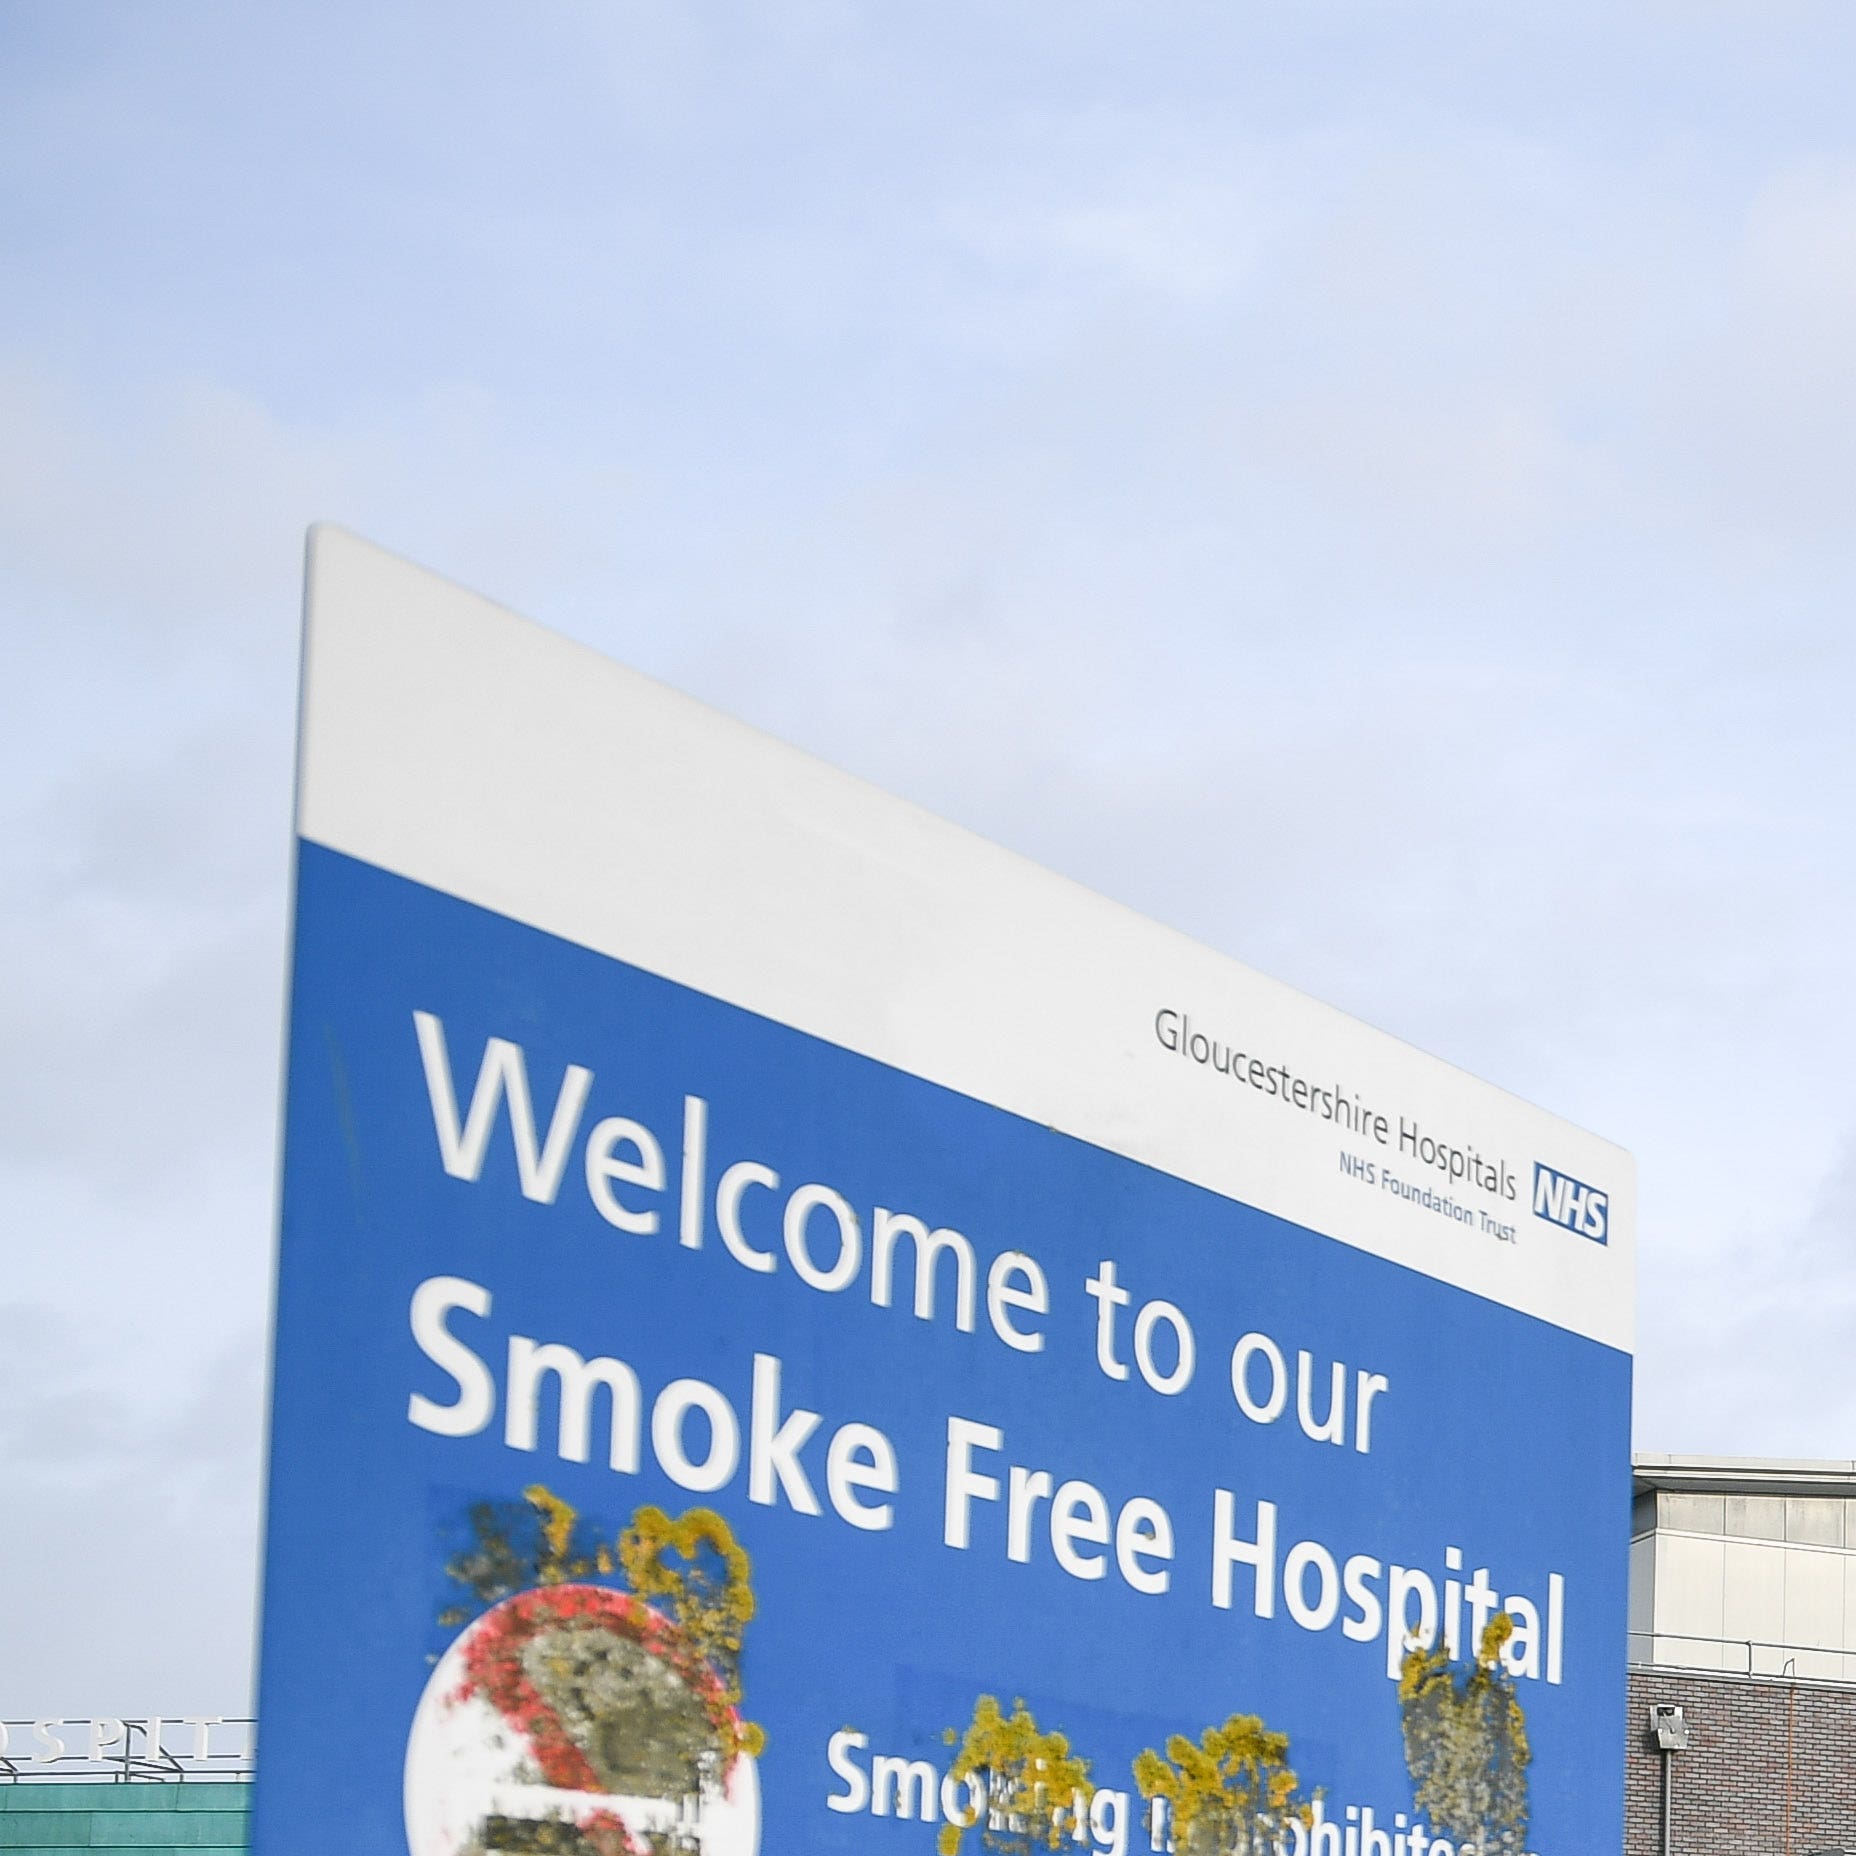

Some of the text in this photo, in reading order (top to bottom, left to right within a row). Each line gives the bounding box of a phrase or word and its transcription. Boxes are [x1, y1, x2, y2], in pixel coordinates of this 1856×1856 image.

[412, 1010, 1390, 1454] Welcome to our
[1154, 1008, 1606, 1244] Gloucestershire Hospitals NHS
[1339, 1152, 1519, 1247] NHS Foundation Trust
[406, 1277, 1565, 1686] Smoke Free Hospital
[0, 1716, 257, 1764] SPIT
